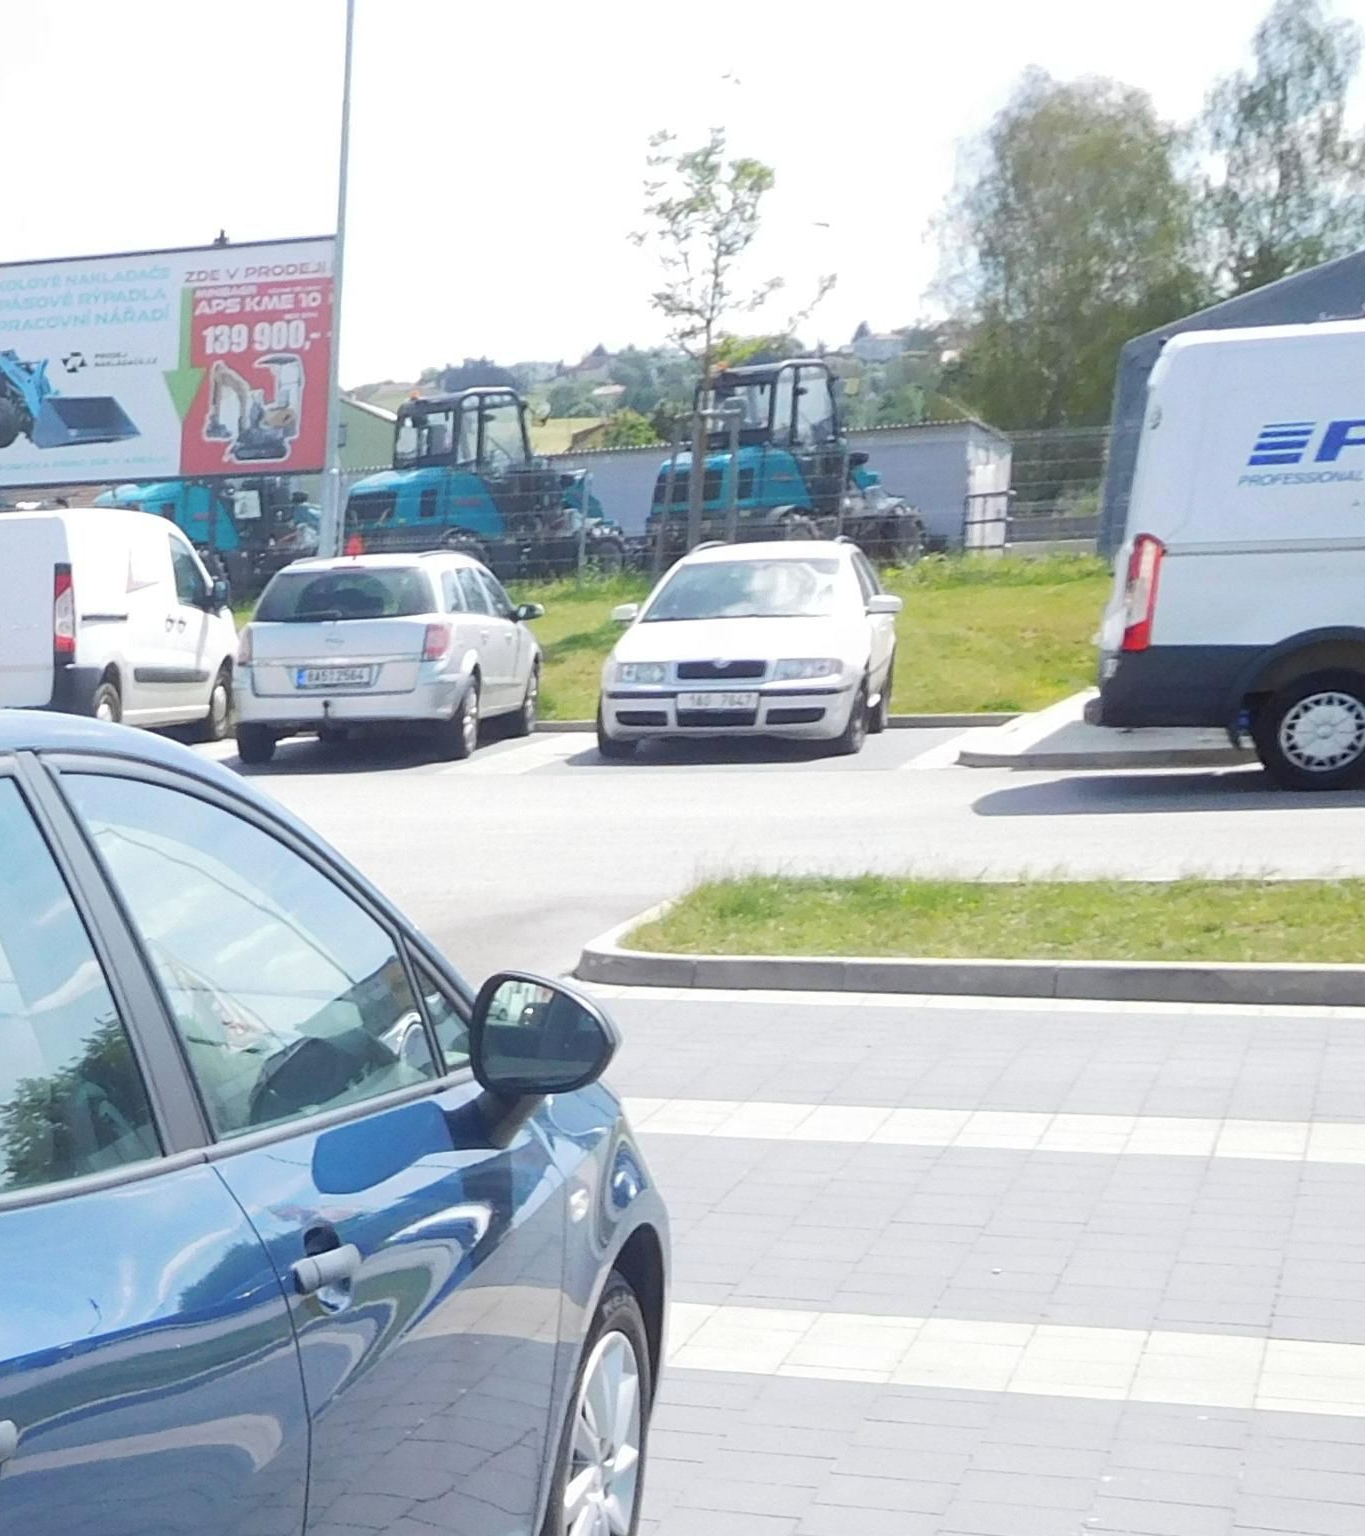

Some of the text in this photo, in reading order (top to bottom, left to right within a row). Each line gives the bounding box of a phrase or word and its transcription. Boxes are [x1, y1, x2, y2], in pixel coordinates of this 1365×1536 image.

[227, 267, 239, 279] V
[194, 292, 322, 315] APS KME 10
[202, 323, 249, 354] 139
